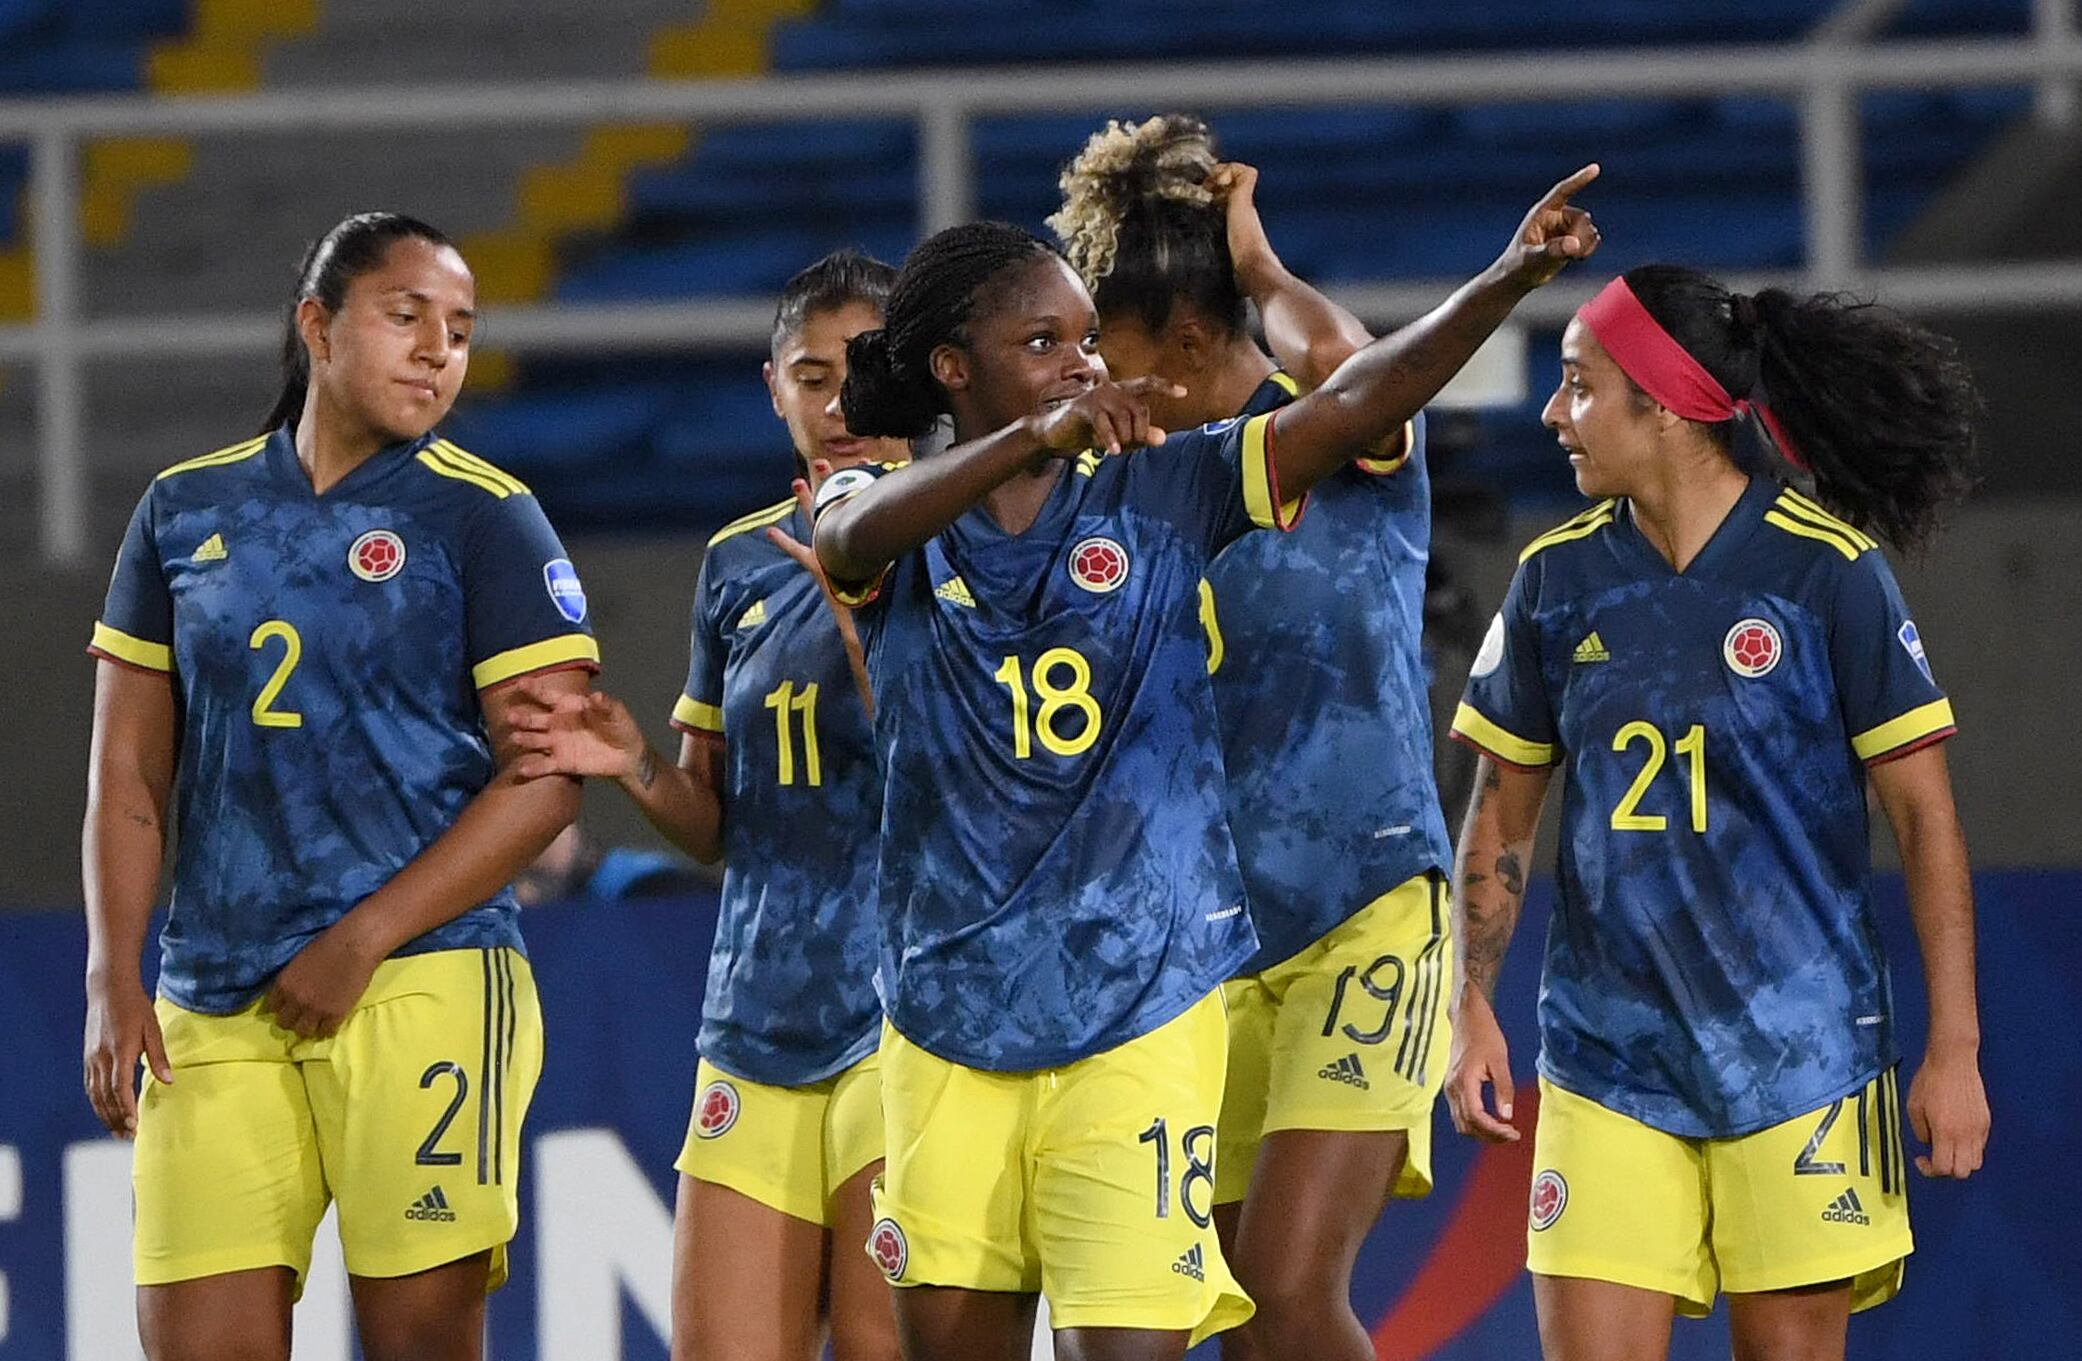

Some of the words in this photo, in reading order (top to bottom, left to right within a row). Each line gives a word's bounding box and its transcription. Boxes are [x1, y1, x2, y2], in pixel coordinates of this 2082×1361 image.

[249, 620, 302, 728] 2
[994, 647, 1102, 759] 18
[765, 680, 821, 786] 11
[1611, 720, 1707, 832] 21
[1321, 955, 1405, 1045] 19
[415, 1061, 468, 1165] 2
[1318, 1068, 1370, 1091] adidas
[404, 1207, 456, 1222] adidas
[1138, 1117, 1214, 1230] 18
[1821, 1209, 1870, 1226] adidas
